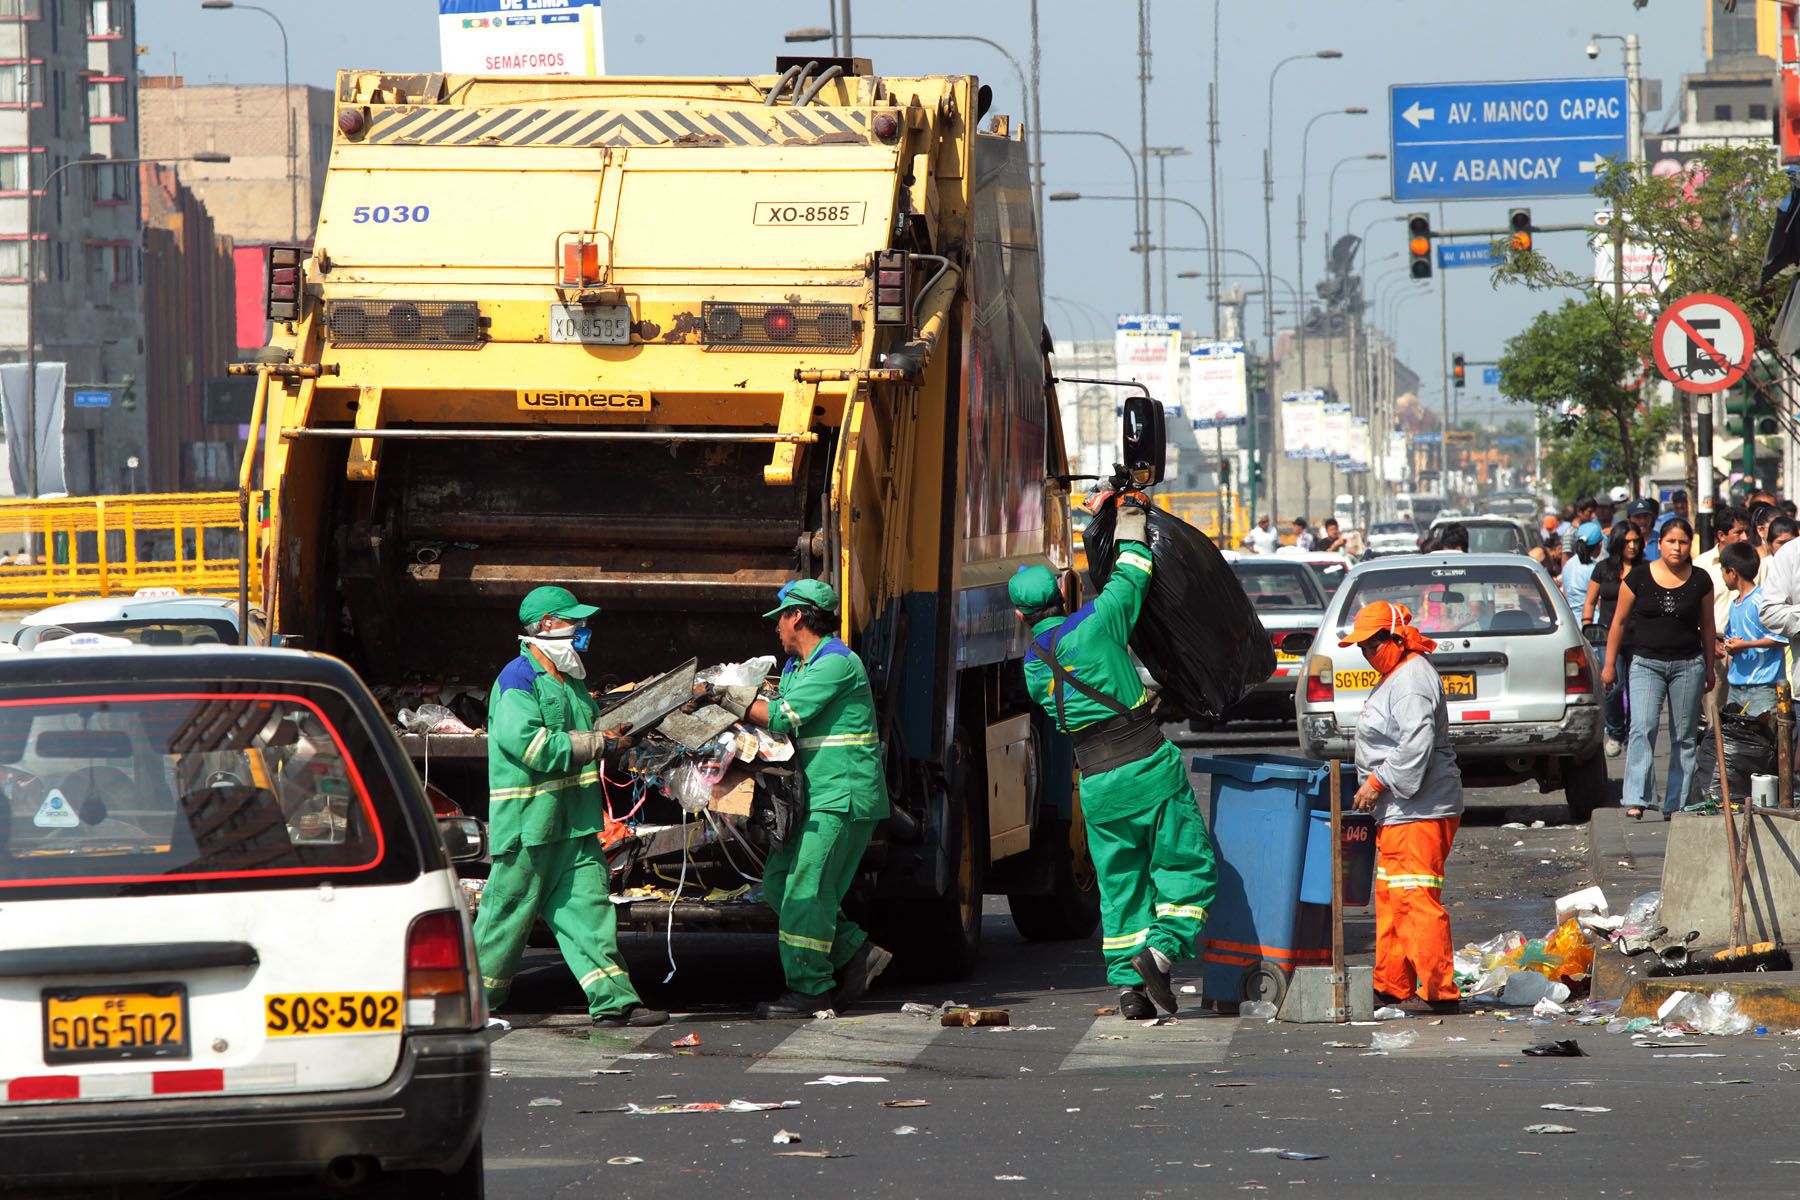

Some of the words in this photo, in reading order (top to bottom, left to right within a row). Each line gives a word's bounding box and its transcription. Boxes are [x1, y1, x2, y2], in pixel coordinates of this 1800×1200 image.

[1448, 102, 1477, 124] AV.
[1483, 99, 1549, 122] MANCO
[1560, 97, 1620, 120] CAPAC
[1407, 161, 1444, 183] AV.
[1453, 157, 1562, 182] ABANCAY
[352, 205, 430, 223] 5030
[768, 206, 850, 222] XO-8585
[524, 392, 644, 407] usimeca
[1346, 826, 1368, 841] 046
[105, 1000, 126, 1011] PE
